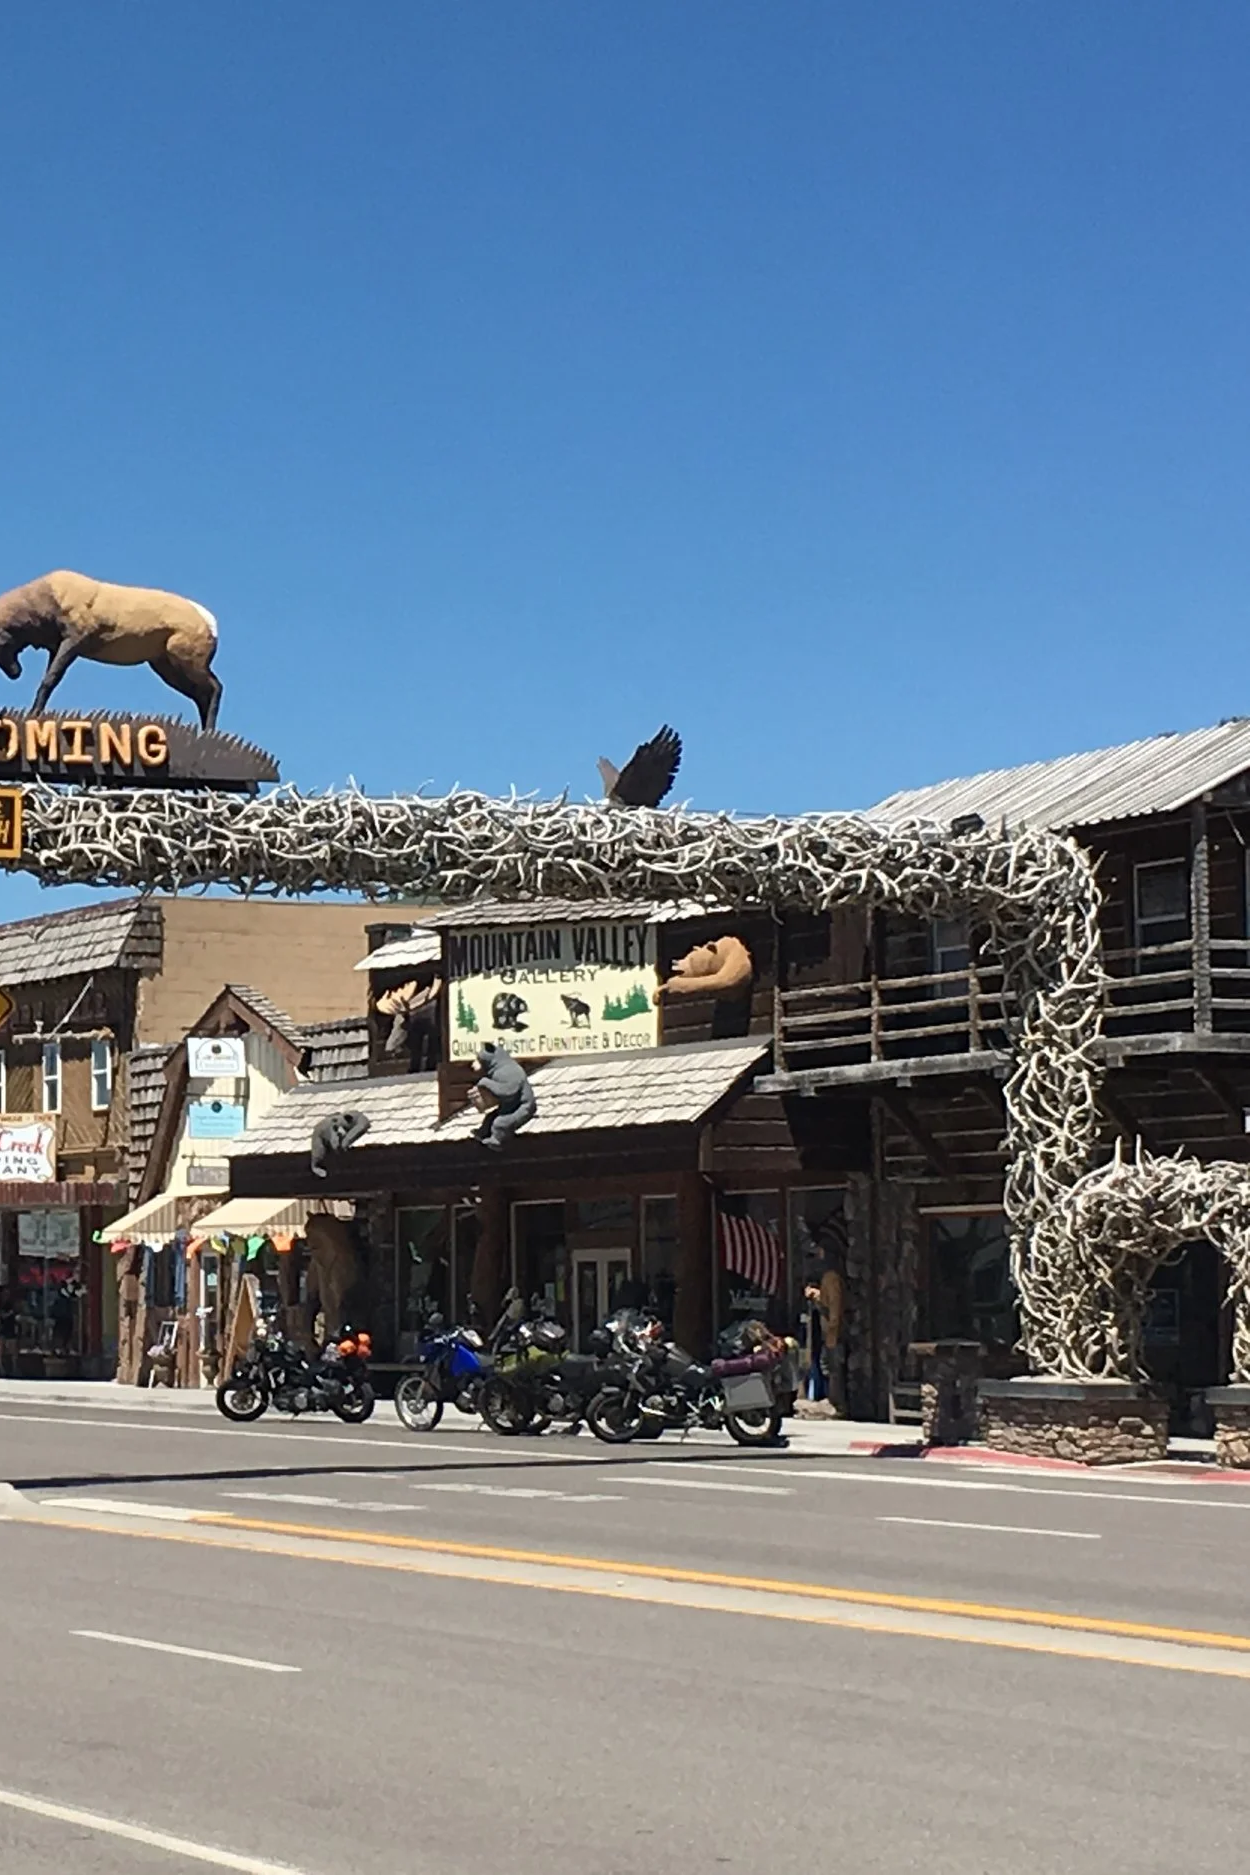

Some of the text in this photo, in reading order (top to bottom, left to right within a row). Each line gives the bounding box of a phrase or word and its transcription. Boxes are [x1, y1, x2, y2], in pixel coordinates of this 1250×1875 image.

[450, 923, 648, 979] MOUNTAIN VALLEY
[501, 967, 598, 985] GALLERY
